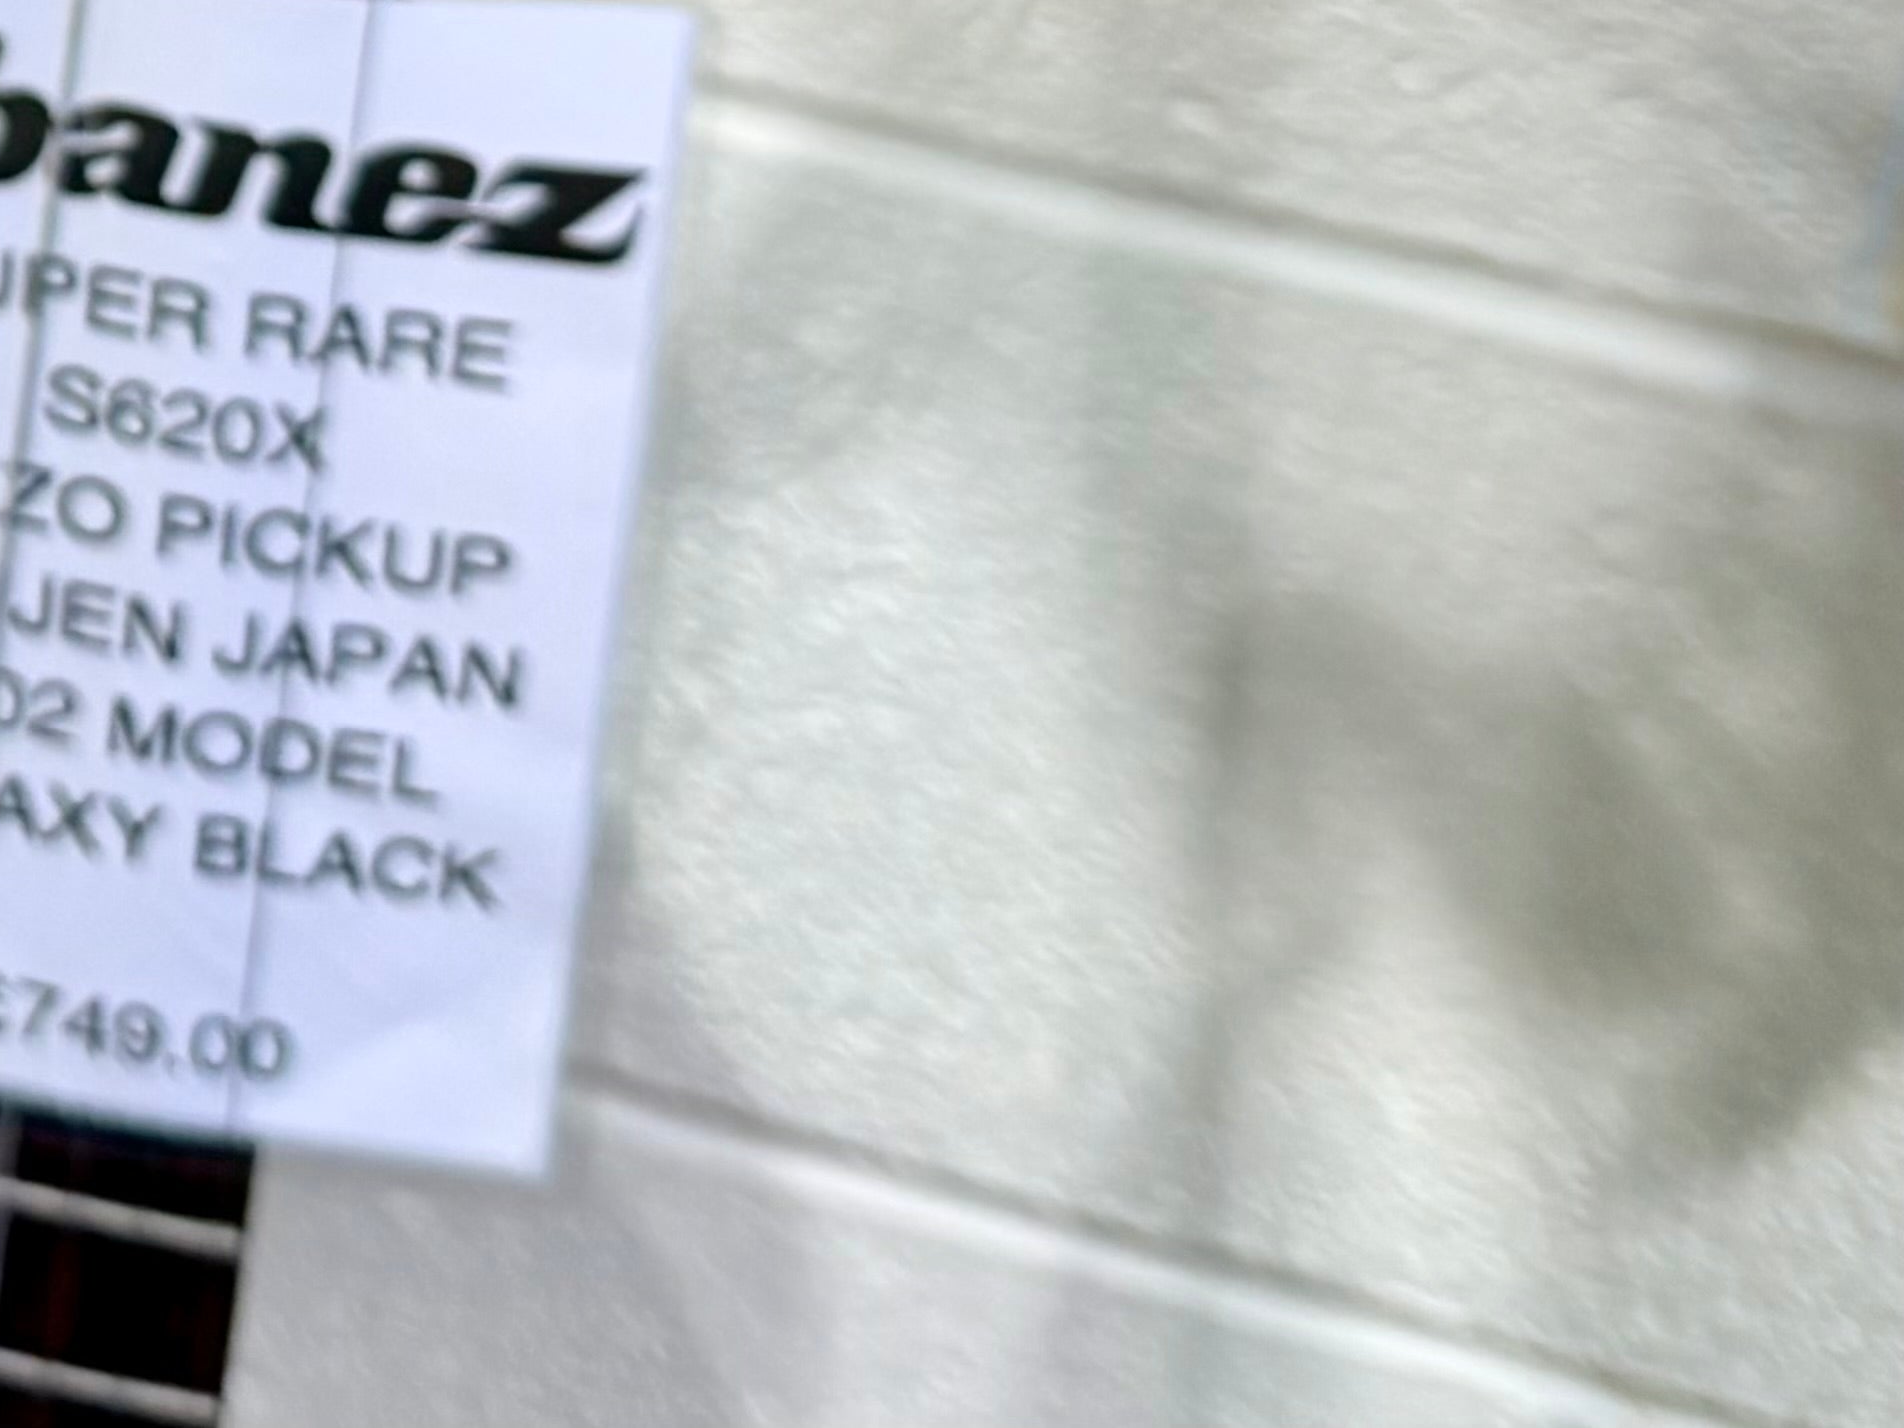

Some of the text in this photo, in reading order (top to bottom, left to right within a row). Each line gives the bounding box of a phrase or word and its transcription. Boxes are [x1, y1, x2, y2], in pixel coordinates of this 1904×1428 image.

[244, 290, 516, 392] RARE
[40, 362, 330, 472] S620X
[154, 490, 514, 602] PICKUP
[210, 610, 526, 712] JAPAN
[104, 692, 442, 806] MODEL
[194, 810, 504, 910] BLACK
